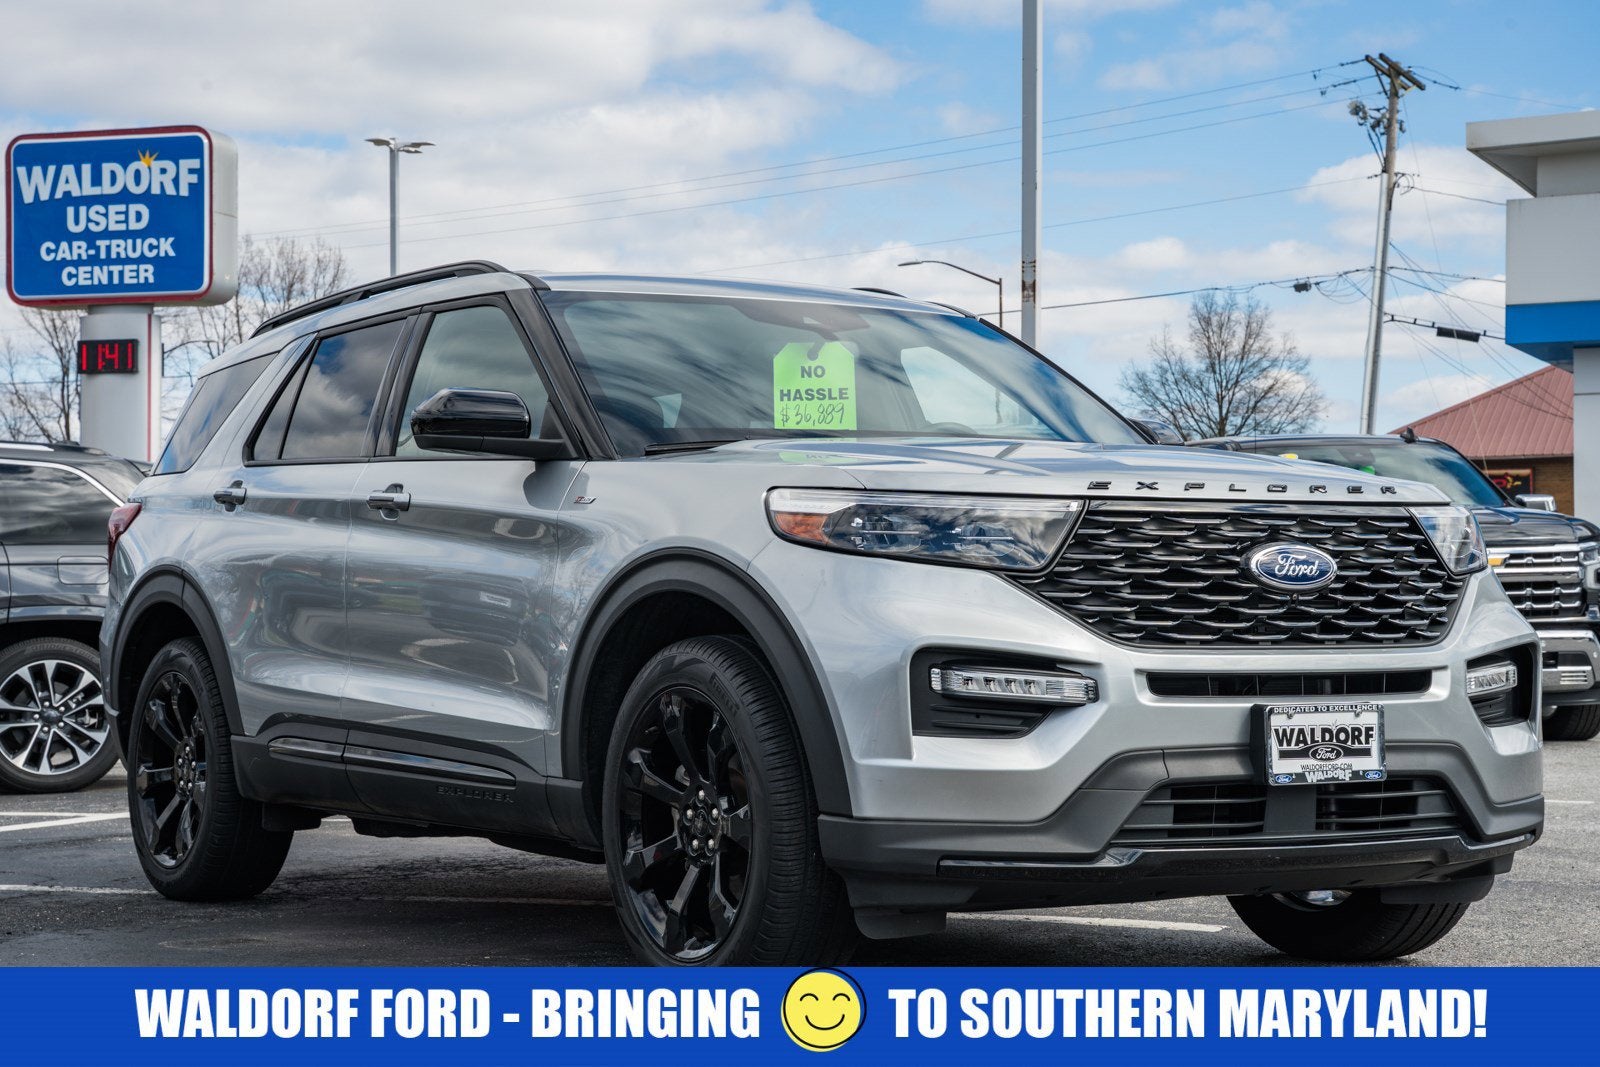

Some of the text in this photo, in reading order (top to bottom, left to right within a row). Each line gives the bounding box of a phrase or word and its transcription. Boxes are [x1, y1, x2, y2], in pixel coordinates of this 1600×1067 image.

[16, 158, 201, 204] WALDORF
[66, 203, 150, 233] USED
[39, 237, 176, 262] CAR-TRUCK
[61, 264, 155, 287] CENTER
[800, 365, 826, 379] NO
[779, 387, 850, 402] HASSLE
[1086, 480, 1398, 495] EXPLORER
[1274, 553, 1320, 578] Ford
[1273, 703, 1378, 713] DEDICATED TO EXCELLENCE
[1272, 725, 1376, 748] WALDORF
[1315, 747, 1337, 760] Ford
[1304, 769, 1352, 783] WALDORF
[436, 784, 515, 803] EXPLORER
